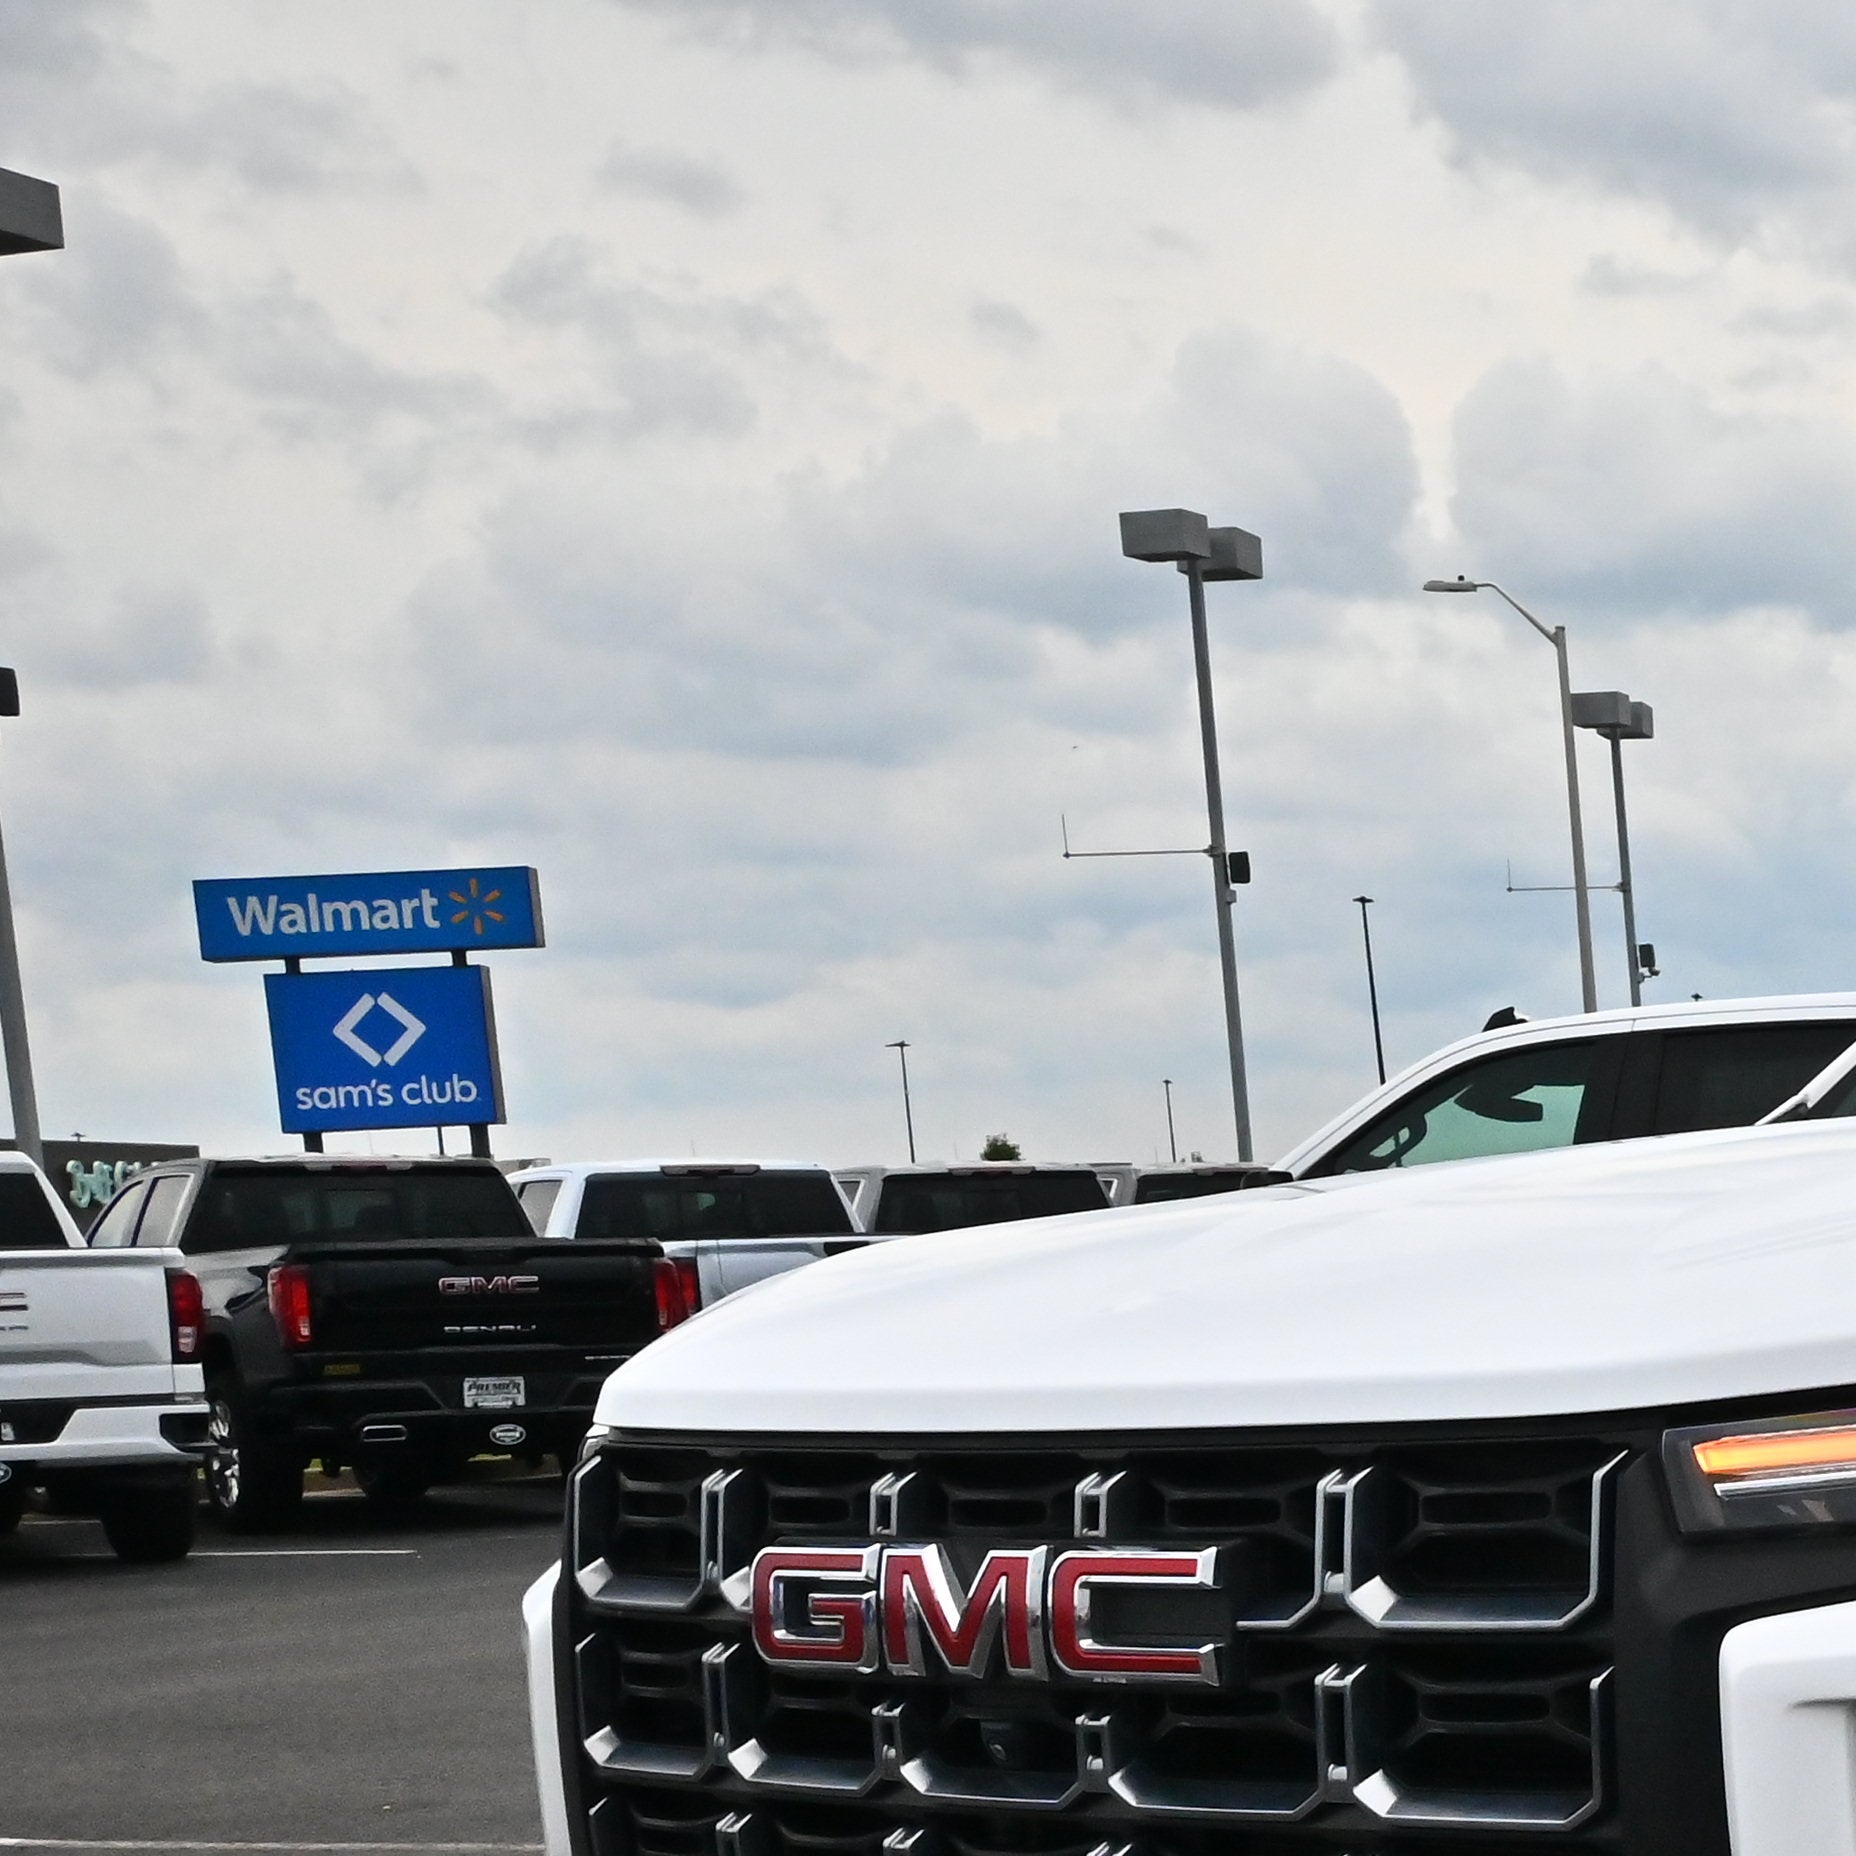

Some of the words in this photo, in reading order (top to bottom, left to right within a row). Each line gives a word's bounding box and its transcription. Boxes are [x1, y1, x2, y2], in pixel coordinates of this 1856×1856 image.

[226, 888, 441, 936] Walmart
[295, 1078, 394, 1111] sam's
[401, 1073, 478, 1104] club
[438, 1275, 540, 1295] GMC
[750, 1540, 1220, 1686] GMC
